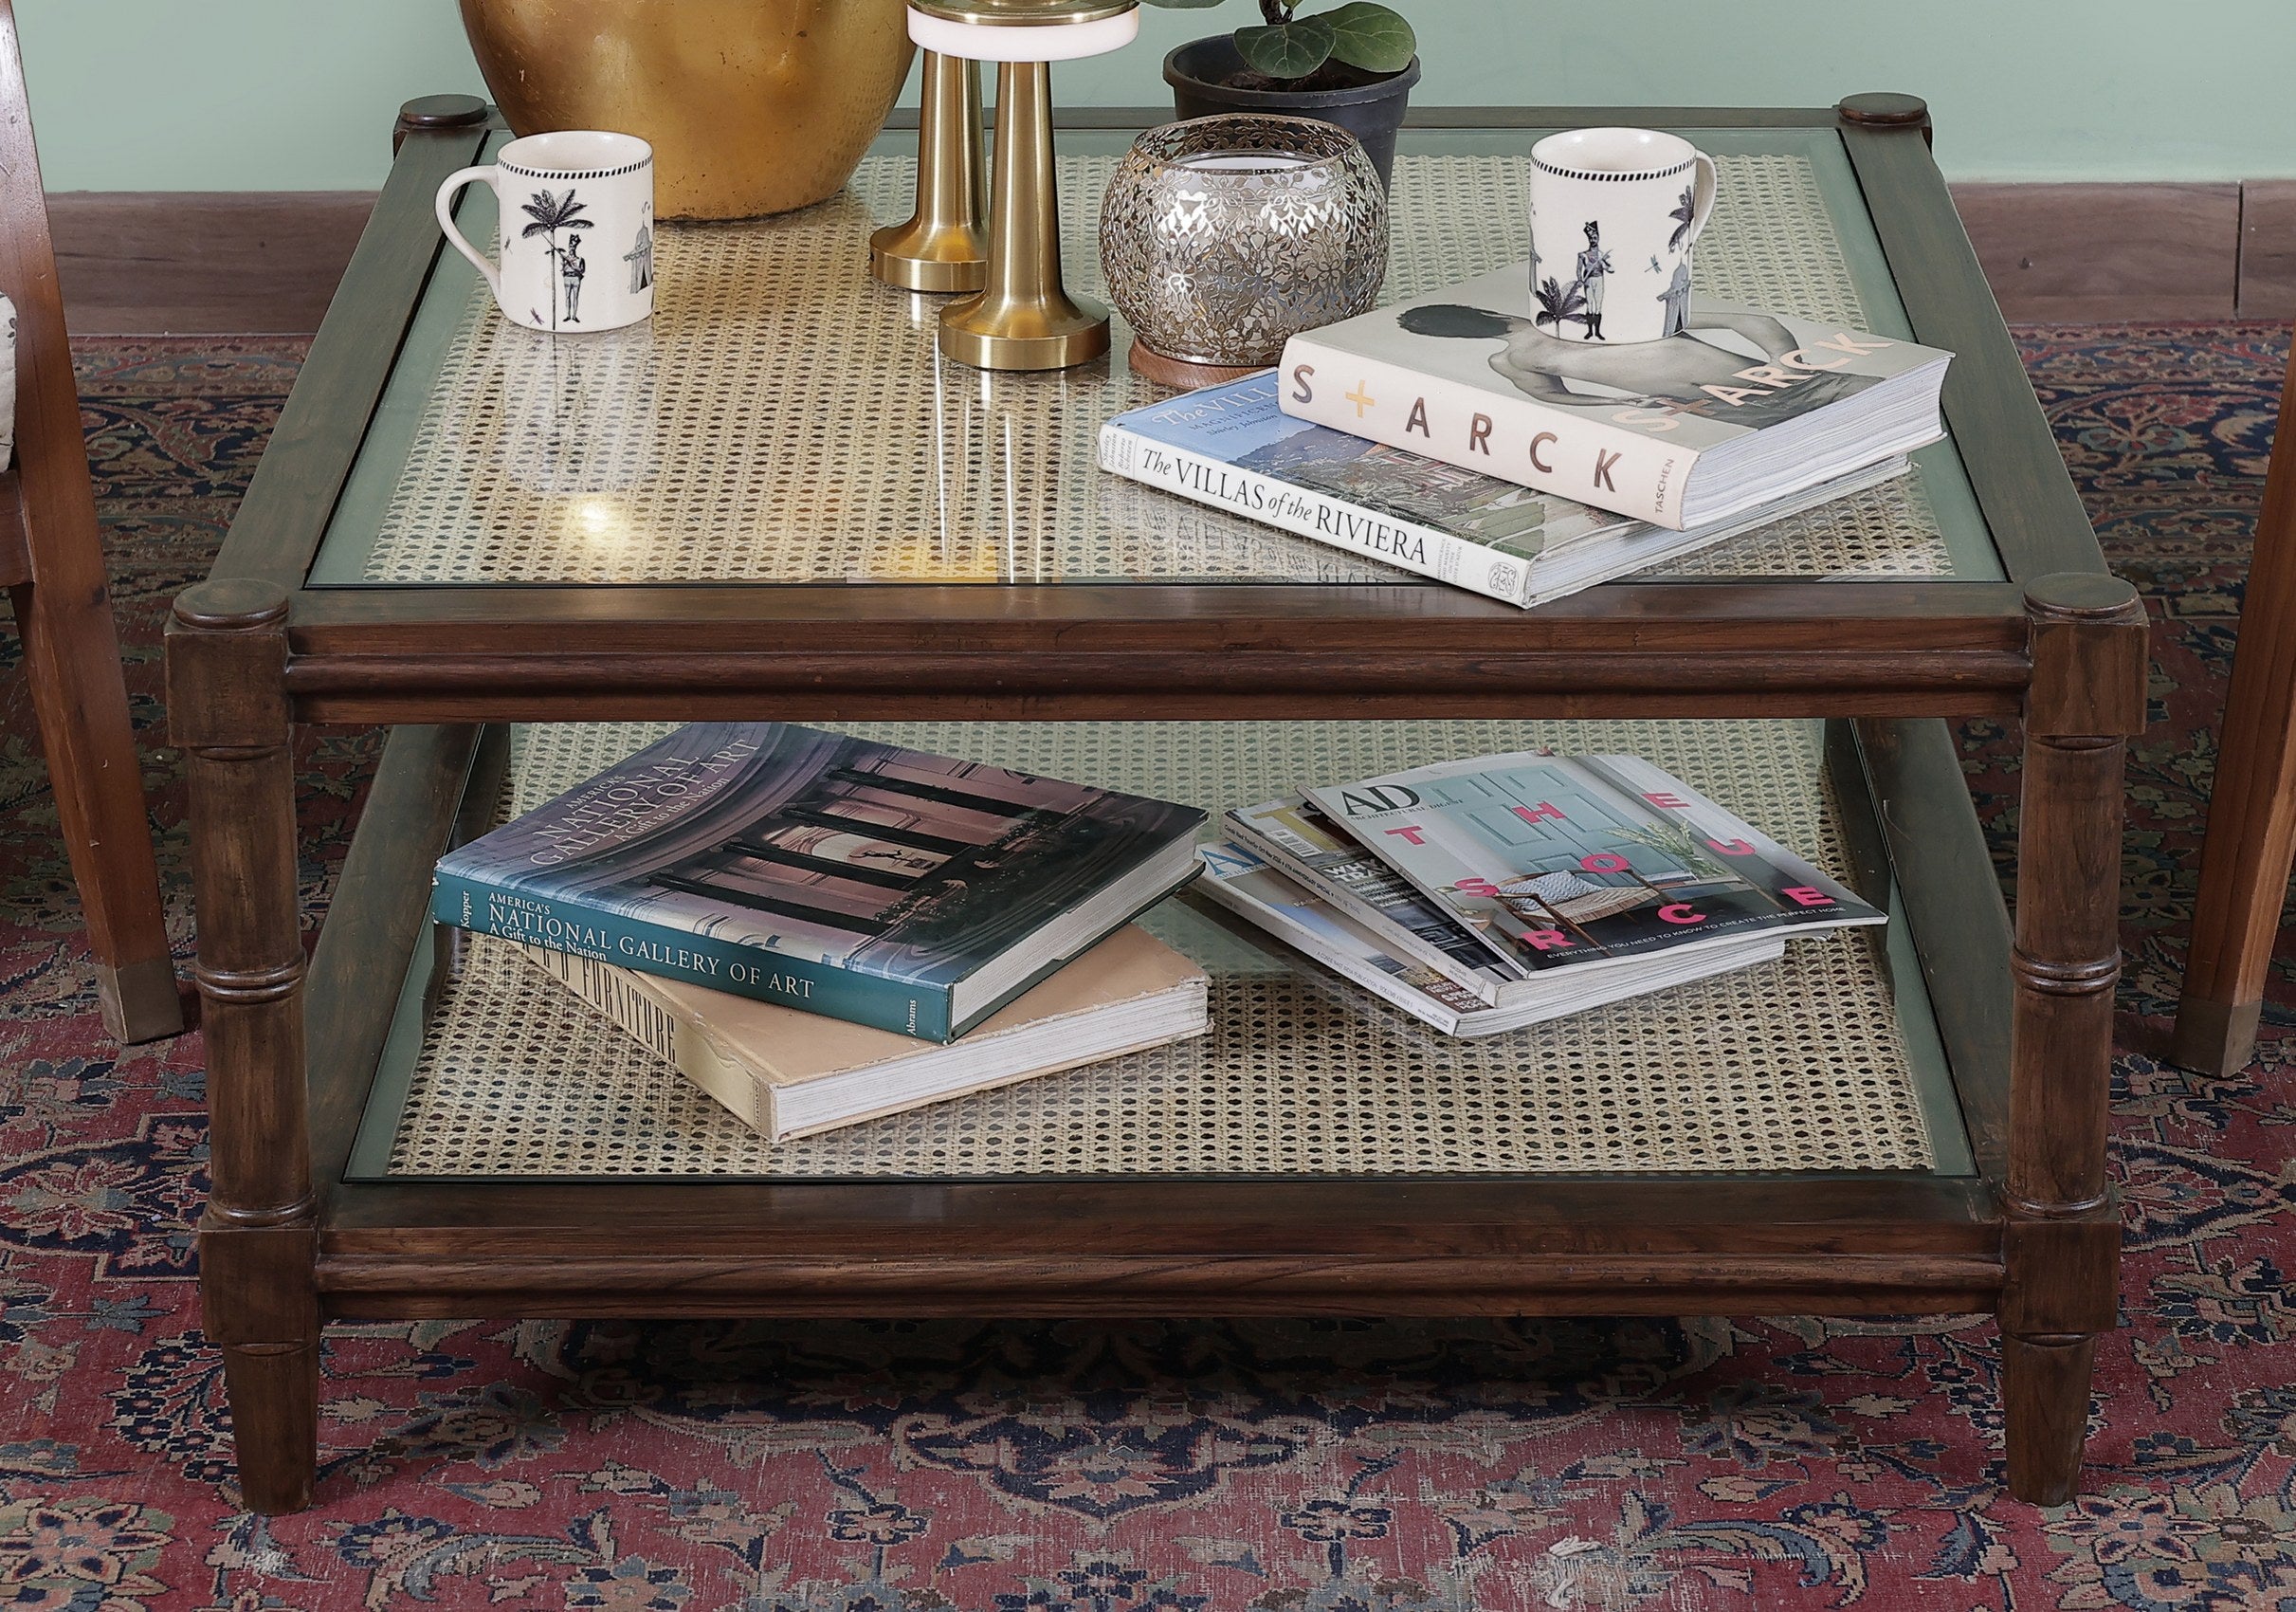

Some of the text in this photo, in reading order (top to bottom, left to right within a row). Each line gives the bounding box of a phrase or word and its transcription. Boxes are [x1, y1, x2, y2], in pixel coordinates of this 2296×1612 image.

[1152, 381, 1278, 426] The VILL
[1189, 401, 1279, 430] MAGNIFICENC
[1207, 414, 1278, 436] Shirley Johnston
[1142, 448, 1428, 565] The VILLAS of the RIVIERA
[1655, 458, 1675, 514] TASCHEN
[531, 739, 760, 866] GALLERY OF ART
[533, 755, 700, 839] NATIONAL
[614, 778, 731, 843] A Gift to the Nation
[1341, 784, 1420, 815] AD
[1351, 805, 1427, 821] ARCHITECTURAL
[1323, 858, 1379, 874] WHY
[459, 890, 472, 928] Kopper
[489, 891, 551, 915] AMERICA'S
[489, 923, 608, 962] A Gift to the Nation
[489, 903, 815, 998] NATIONAL GALLERY OF ART
[1547, 944, 1608, 959] EVERYTHING
[1631, 937, 1656, 946] NEED
[1672, 925, 1704, 936] KNOW
[1719, 916, 1757, 927] CREATE
[1777, 908, 1817, 918] PERFECT
[582, 957, 677, 1064] FURNITURE
[905, 998, 917, 1035] Abrams
